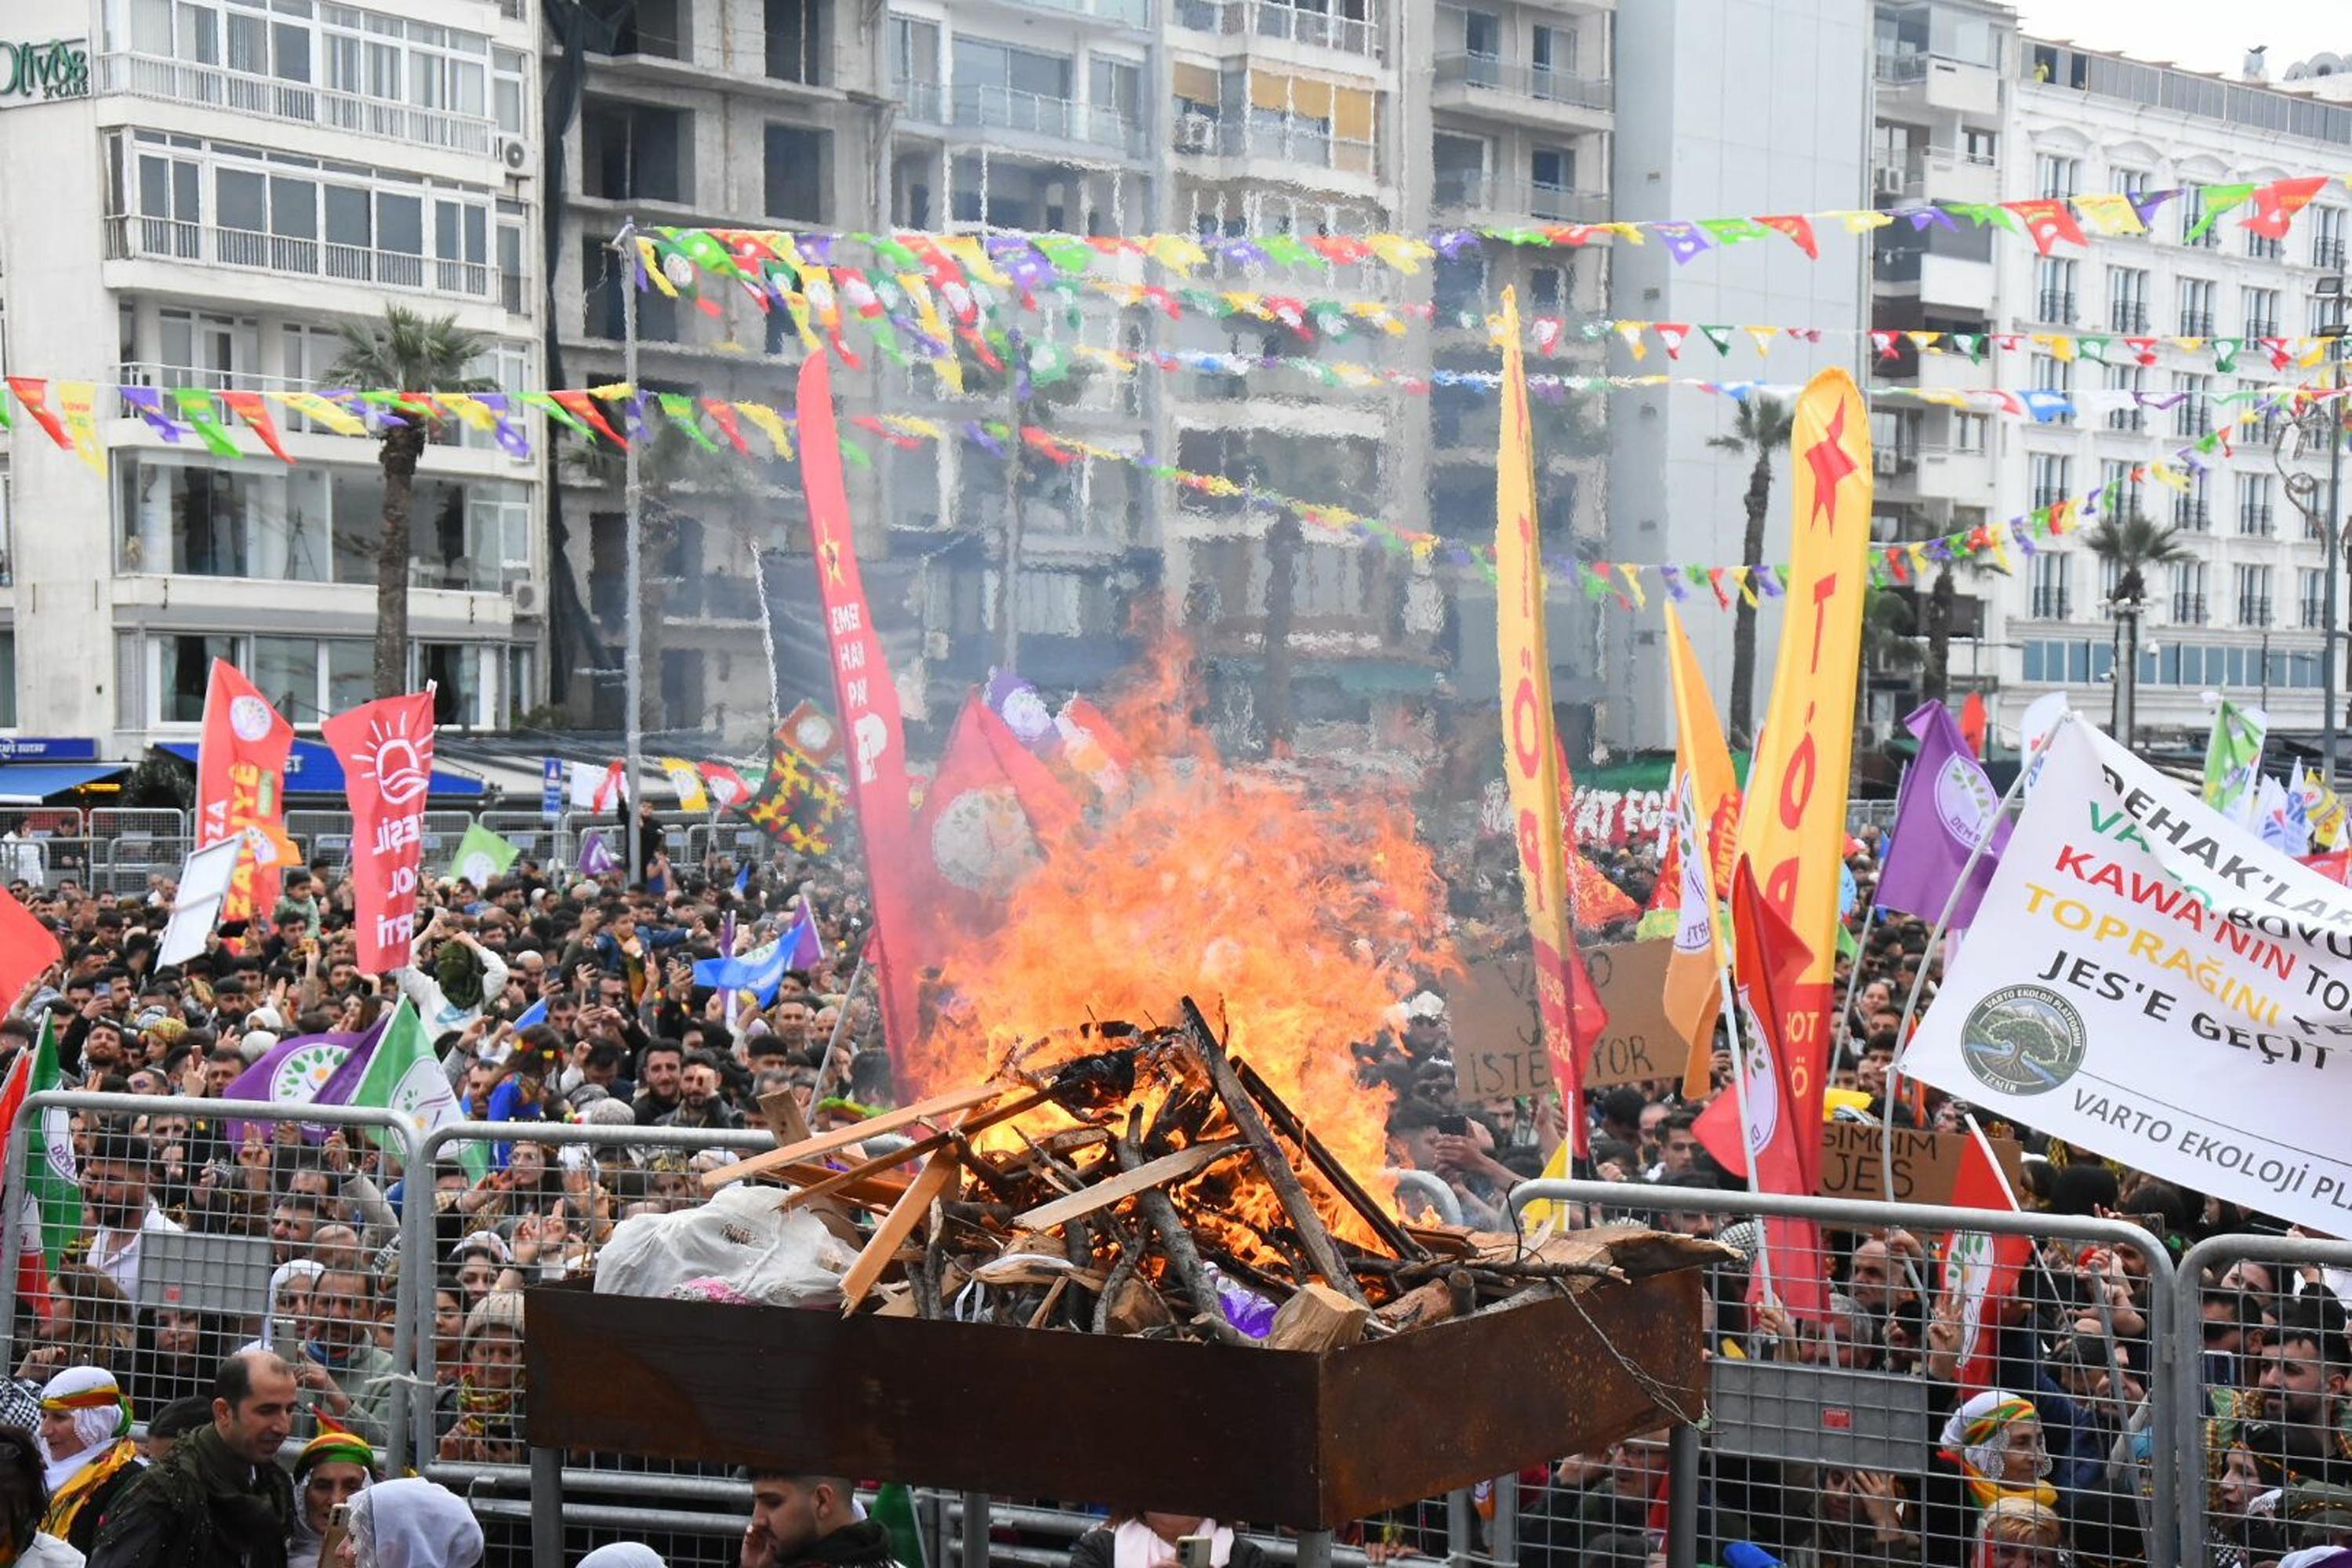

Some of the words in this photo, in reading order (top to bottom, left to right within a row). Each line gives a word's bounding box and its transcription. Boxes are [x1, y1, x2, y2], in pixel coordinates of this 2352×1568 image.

[1950, 815, 1973, 840] DEM
[2024, 882, 2284, 1028] TOPRAĞINI
[2054, 844, 2296, 982] KAWA'NIN
[2307, 964, 2352, 1011] TO
[1985, 989, 2014, 1009] VARTO
[2053, 1000, 2082, 1047] PLATFORMU
[2038, 949, 2177, 1023] JES'E
[2190, 1011, 2335, 1070] GEÇİT
[2074, 1088, 2172, 1143] VARTO
[1824, 1152, 1914, 1199] JES
